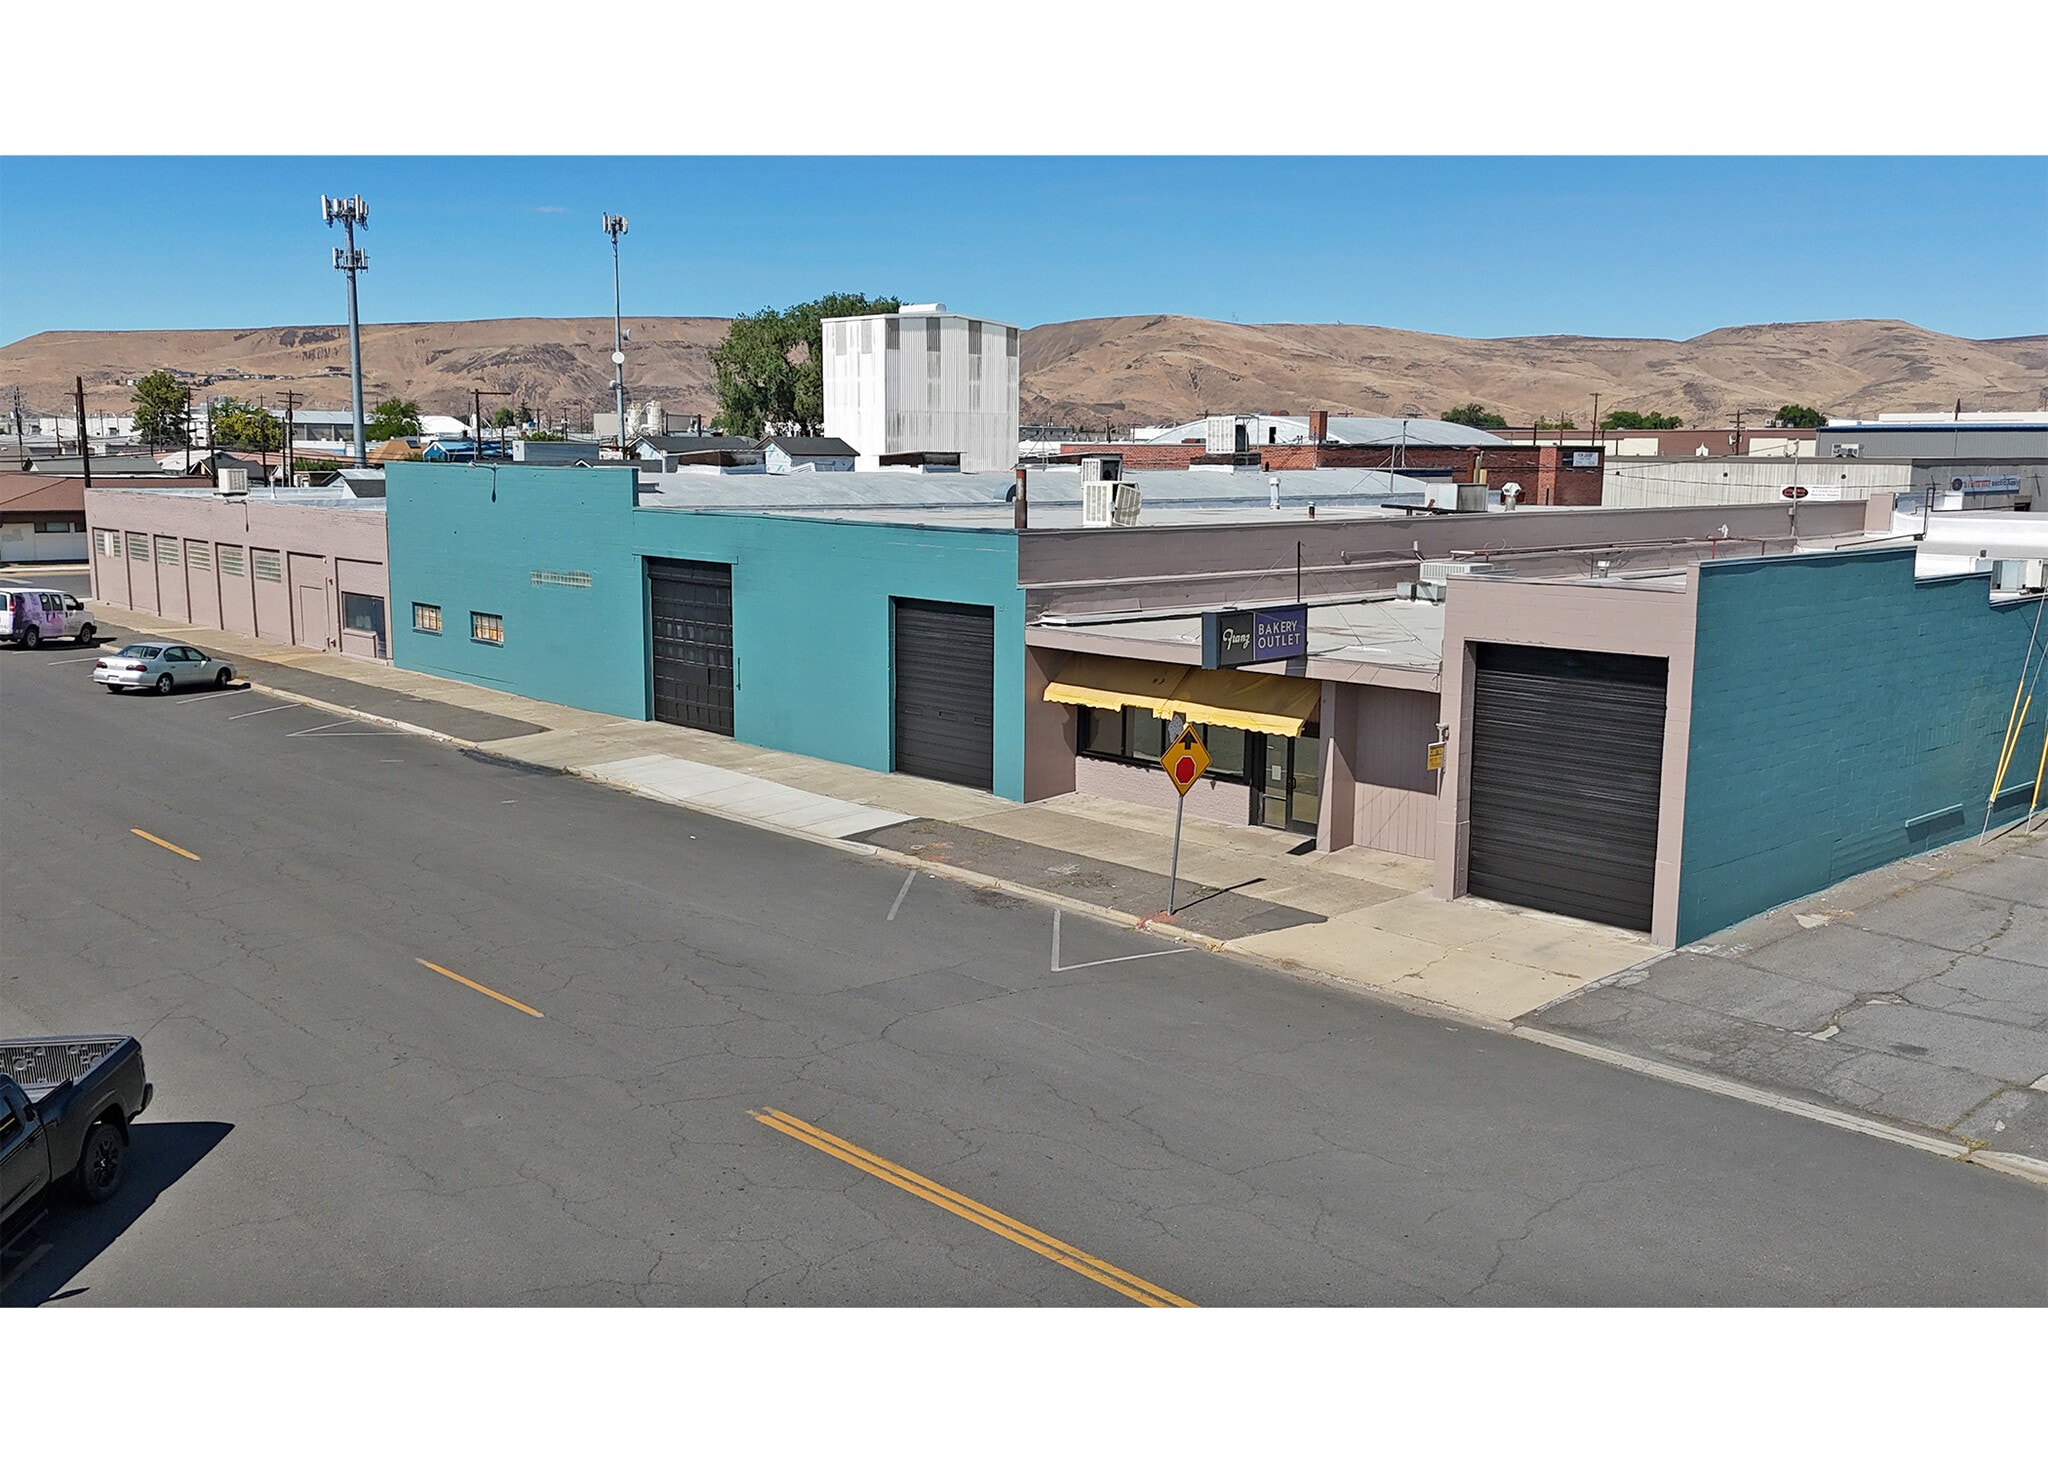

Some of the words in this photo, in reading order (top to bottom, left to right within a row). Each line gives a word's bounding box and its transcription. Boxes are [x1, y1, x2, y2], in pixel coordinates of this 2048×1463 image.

[1258, 620, 1298, 635] BAKERY
[1222, 628, 1251, 651] Franz
[1258, 633, 1301, 649] OUTLET
